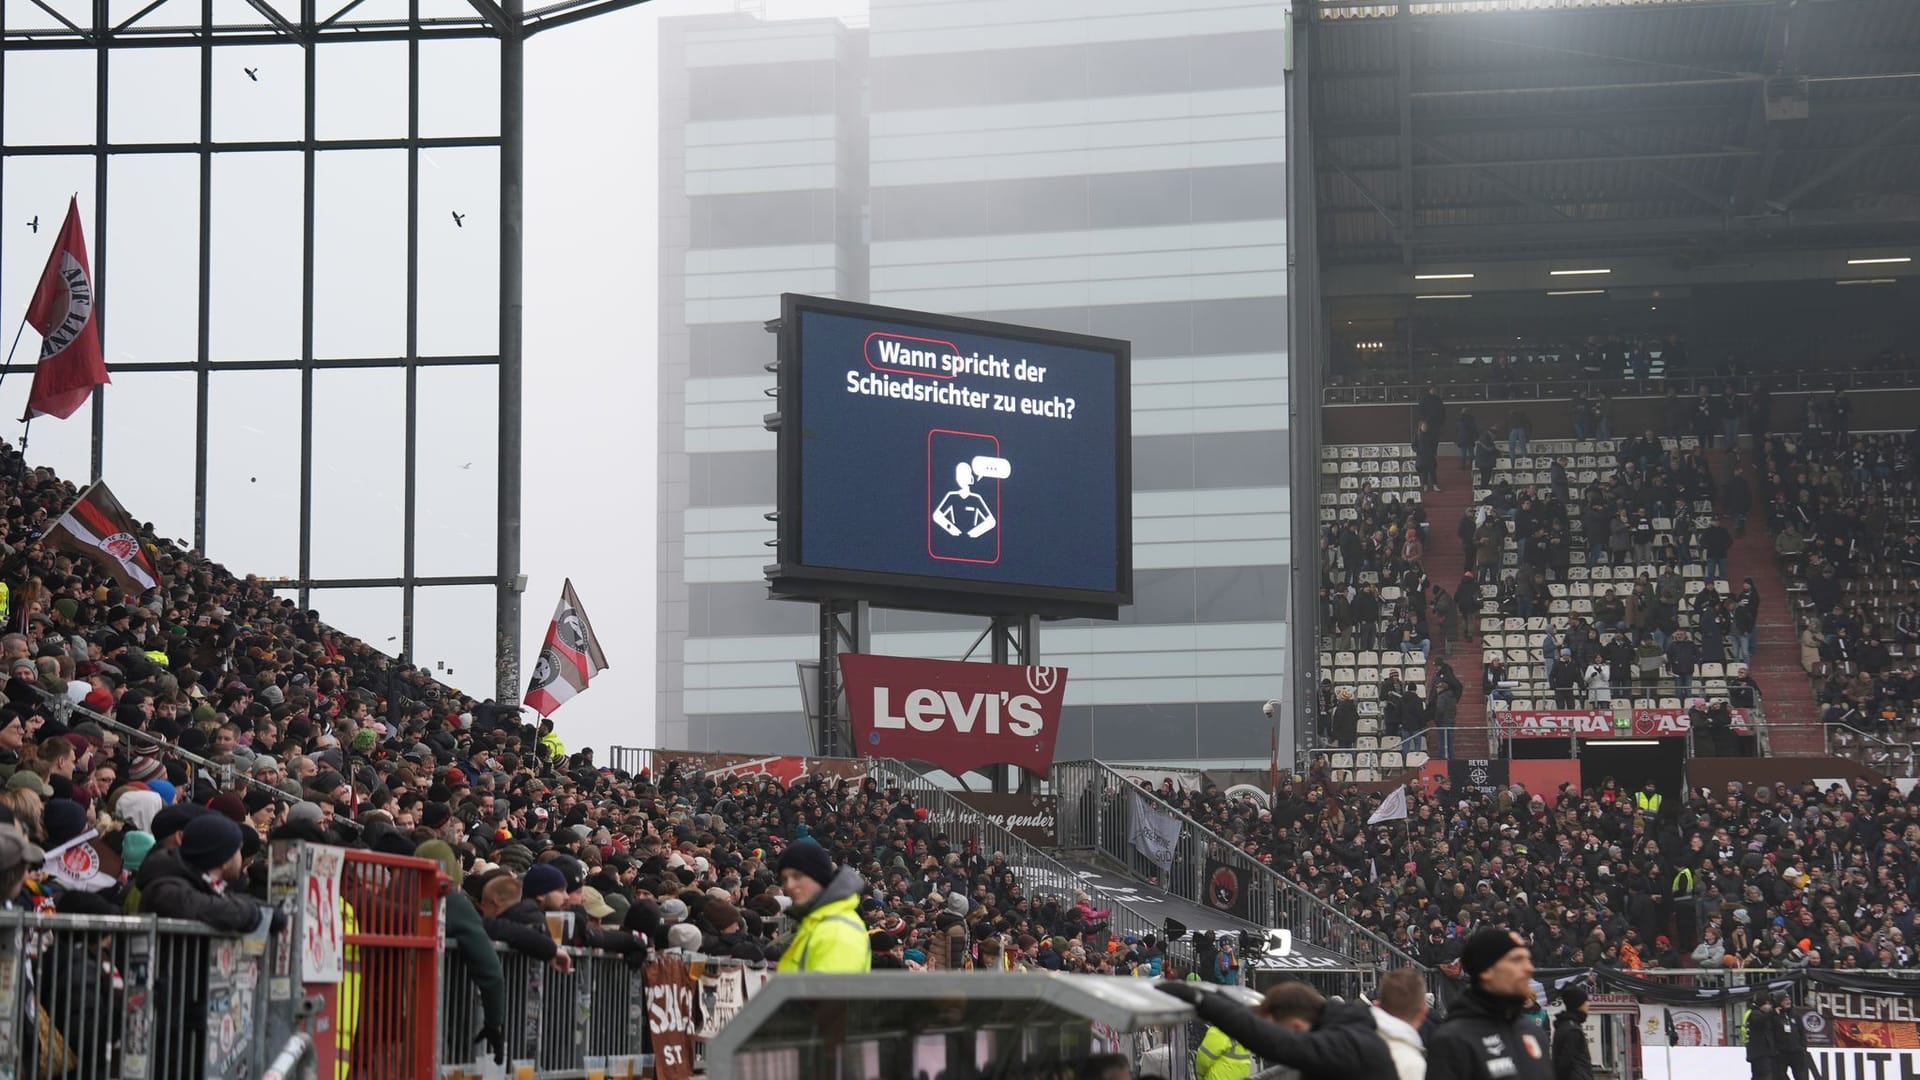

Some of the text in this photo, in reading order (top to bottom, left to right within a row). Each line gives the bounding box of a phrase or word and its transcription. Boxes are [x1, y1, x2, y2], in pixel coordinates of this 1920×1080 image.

[62, 268, 91, 305] AUF
[878, 340, 1047, 383] Wann spricht der
[847, 370, 1075, 420] Schiedsrichter zu euch?
[1522, 715, 1610, 732] ASTRA
[1004, 811, 1055, 832] gender
